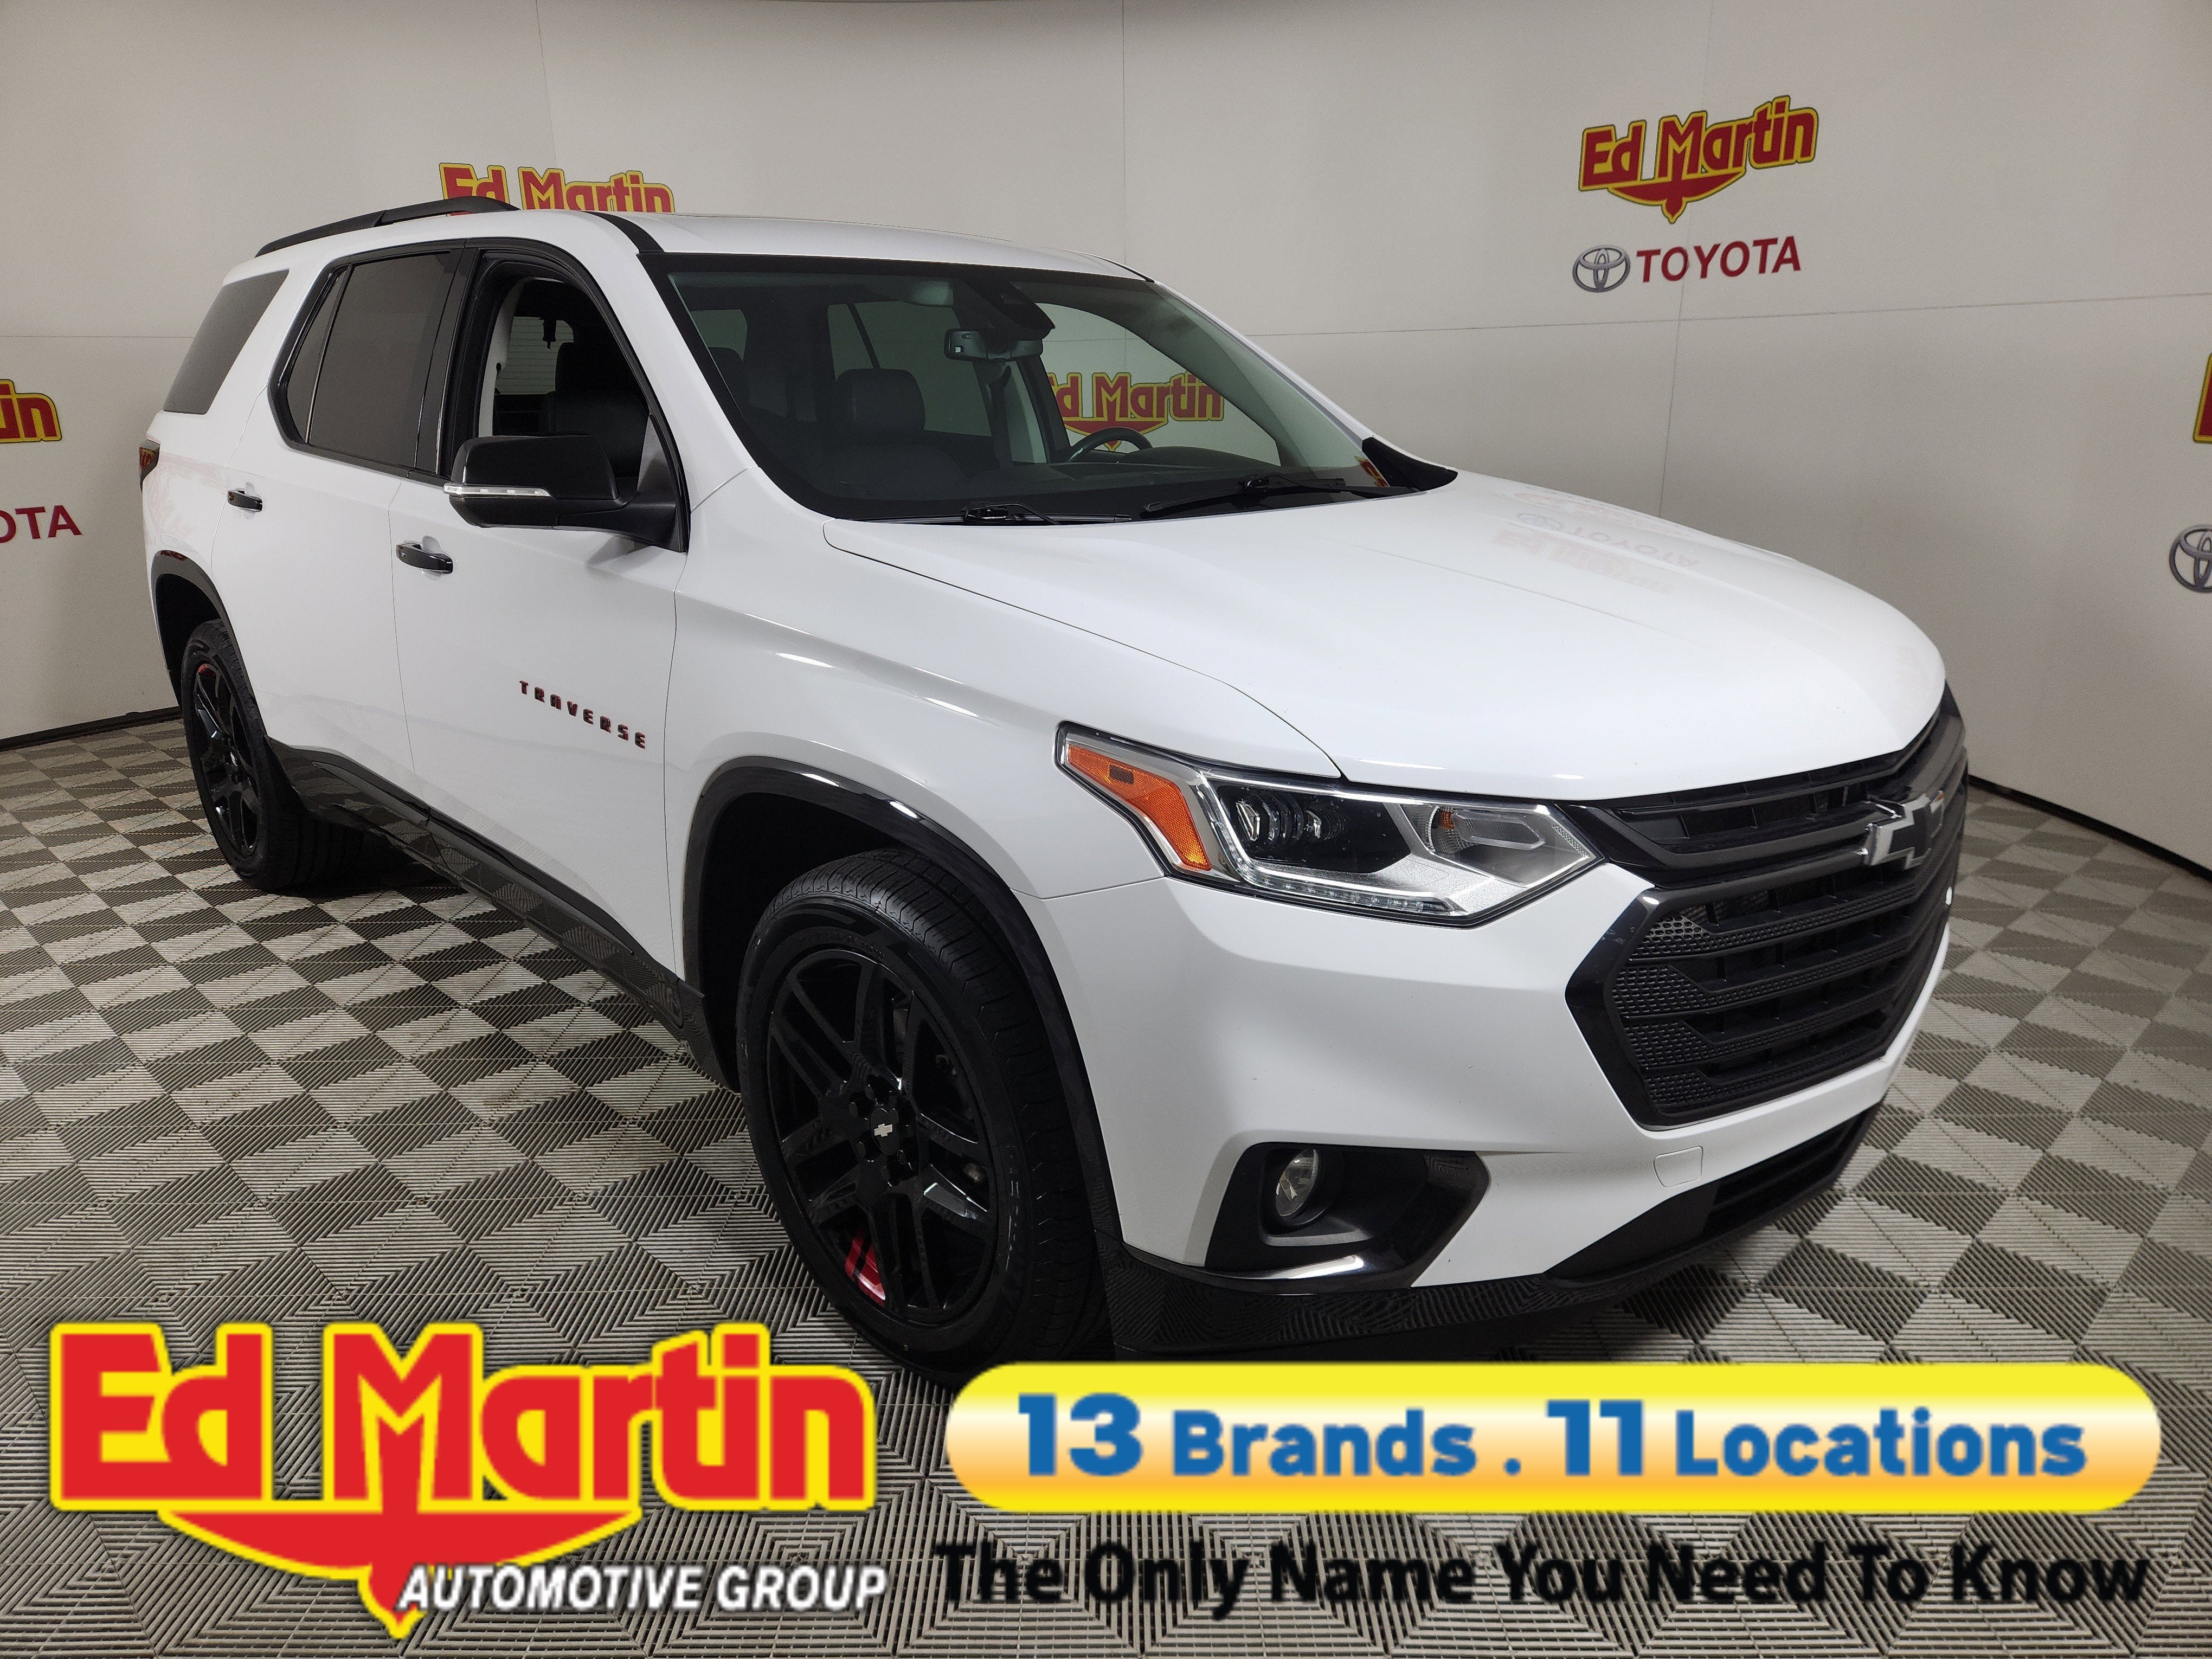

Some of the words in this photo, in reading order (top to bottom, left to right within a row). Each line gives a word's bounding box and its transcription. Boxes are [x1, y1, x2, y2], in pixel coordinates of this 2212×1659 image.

[1581, 123, 1644, 188] Ed
[1651, 99, 1817, 179] Martin
[442, 165, 507, 201] Ed
[520, 169, 671, 213] Martin
[1636, 236, 1801, 283] TOYOTA
[1049, 374, 1079, 418] d
[1094, 373, 1223, 419] Martin
[519, 680, 646, 749] TRAVERSE
